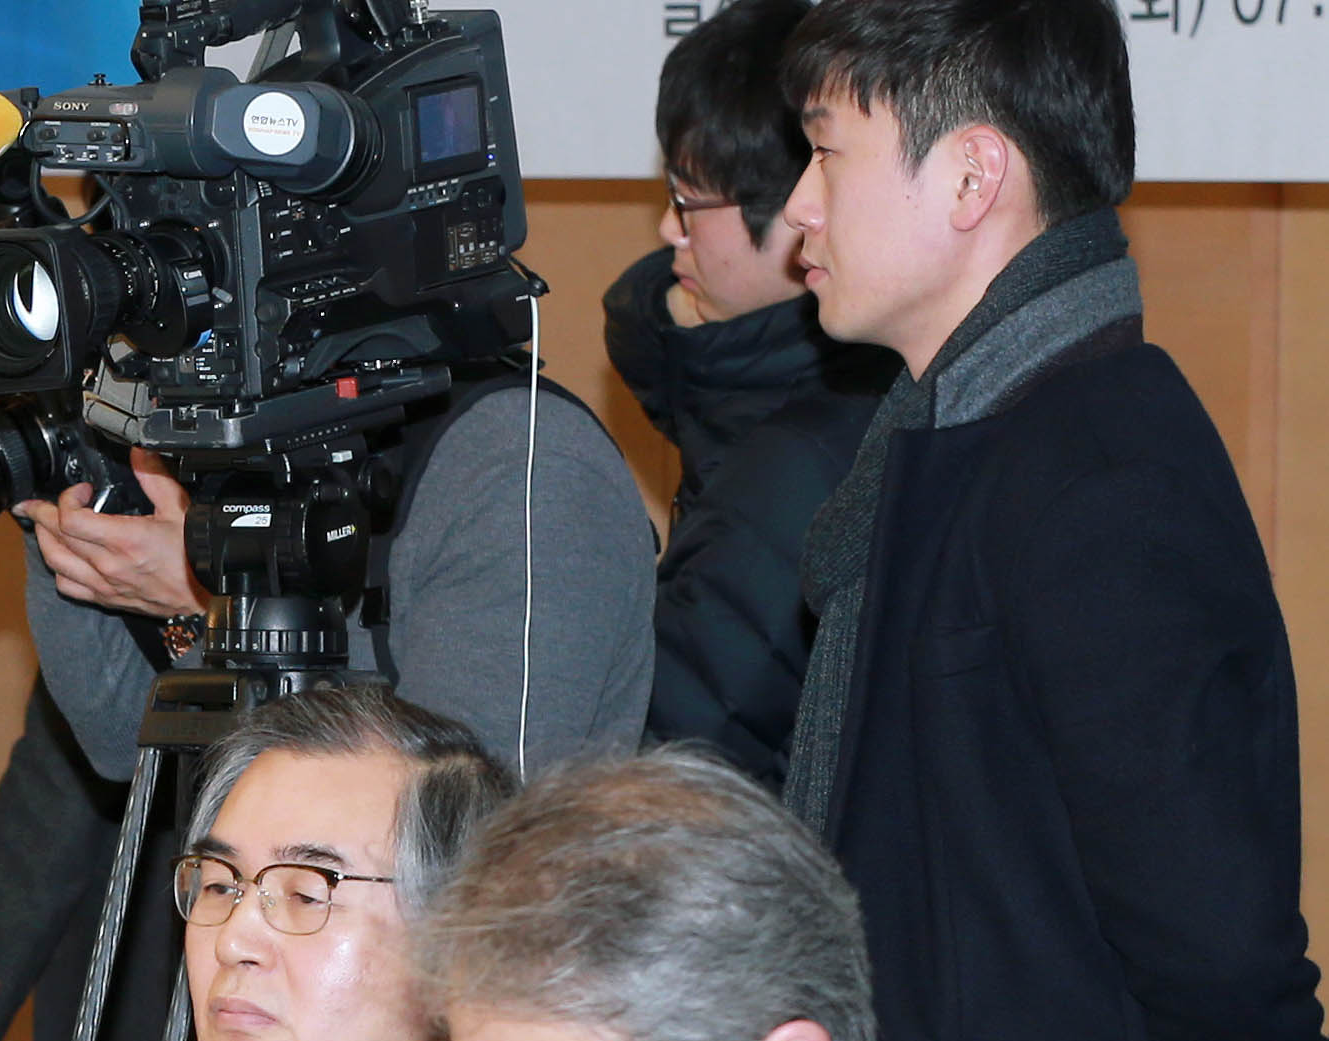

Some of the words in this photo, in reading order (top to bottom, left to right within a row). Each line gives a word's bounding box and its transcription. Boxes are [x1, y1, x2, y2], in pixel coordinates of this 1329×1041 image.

[53, 102, 90, 111] SONY
[251, 115, 299, 127] 연합뉴스TV
[222, 504, 271, 514] compass
[254, 516, 268, 525] 25
[326, 525, 353, 543] MILLER
